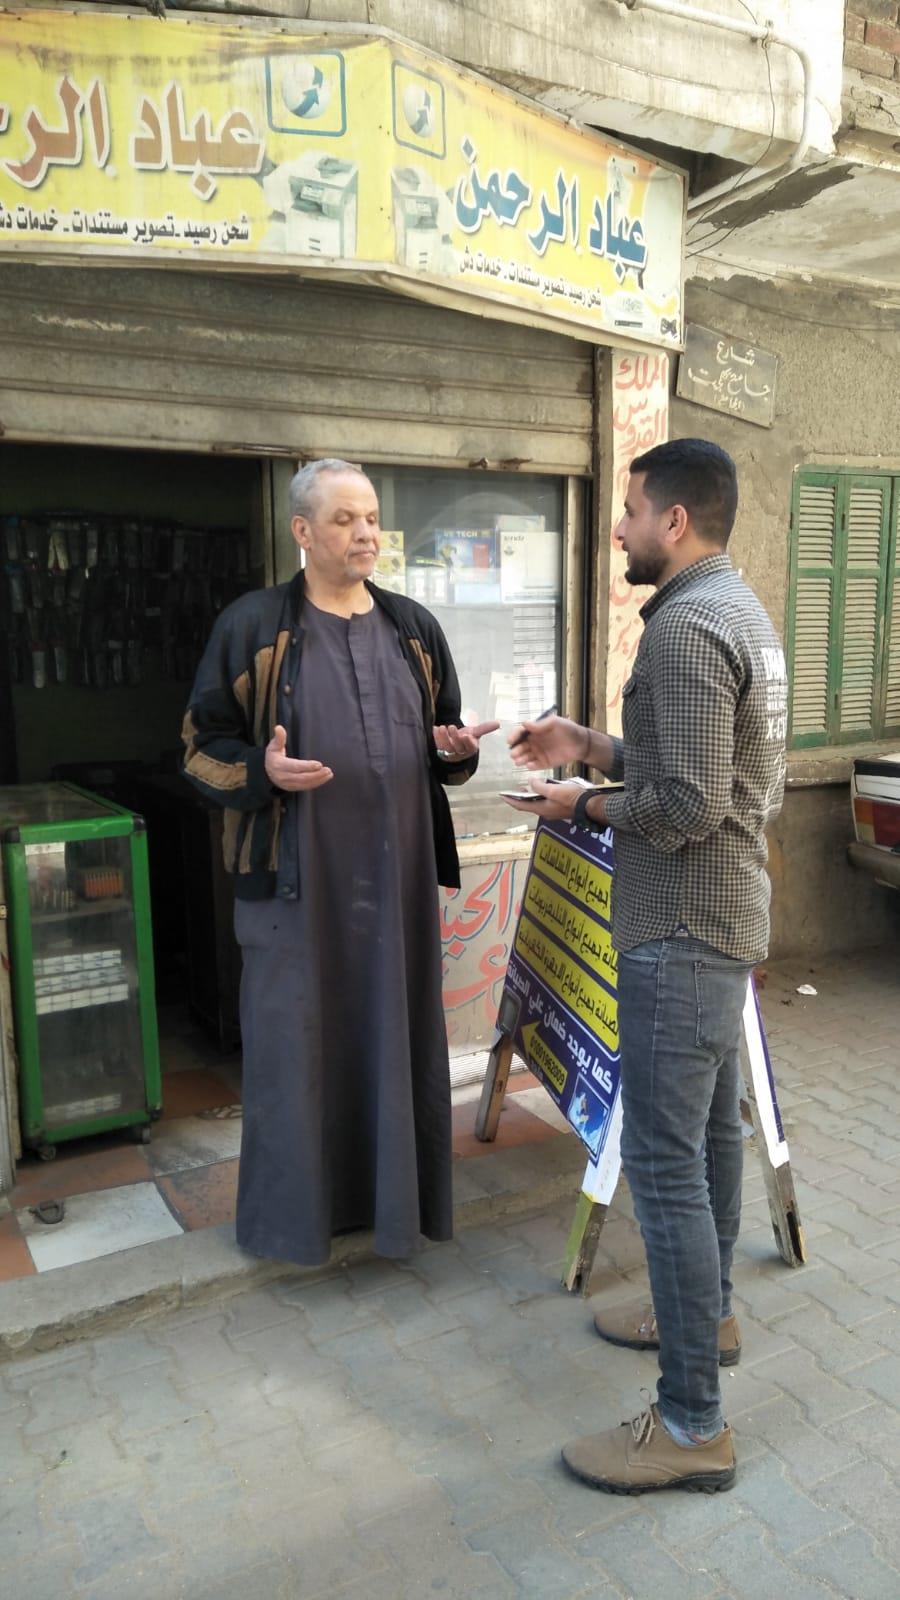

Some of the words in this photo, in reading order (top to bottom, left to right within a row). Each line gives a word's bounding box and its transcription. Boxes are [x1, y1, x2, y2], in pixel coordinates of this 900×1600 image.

[0, 74, 107, 185] الر
[132, 80, 263, 197] عباد
[456, 139, 579, 254] الرحمن
[16, 207, 59, 232] خدمات
[72, 210, 129, 236] مستندات
[133, 214, 175, 244] تصوير
[184, 218, 218, 245] رصيد
[221, 215, 250, 245] شحن
[590, 190, 648, 281] عباد
[460, 245, 474, 273] دش
[476, 253, 502, 277] خدمات
[508, 262, 540, 288] مستندات
[716, 340, 755, 367] شارع
[615, 354, 667, 391] الملك
[580, 932, 602, 960] جميع
[576, 988, 596, 1016] جميع
[543, 1006, 567, 1041] ضمان
[566, 1034, 592, 1075] يوجد
[591, 1057, 613, 1095] كما
